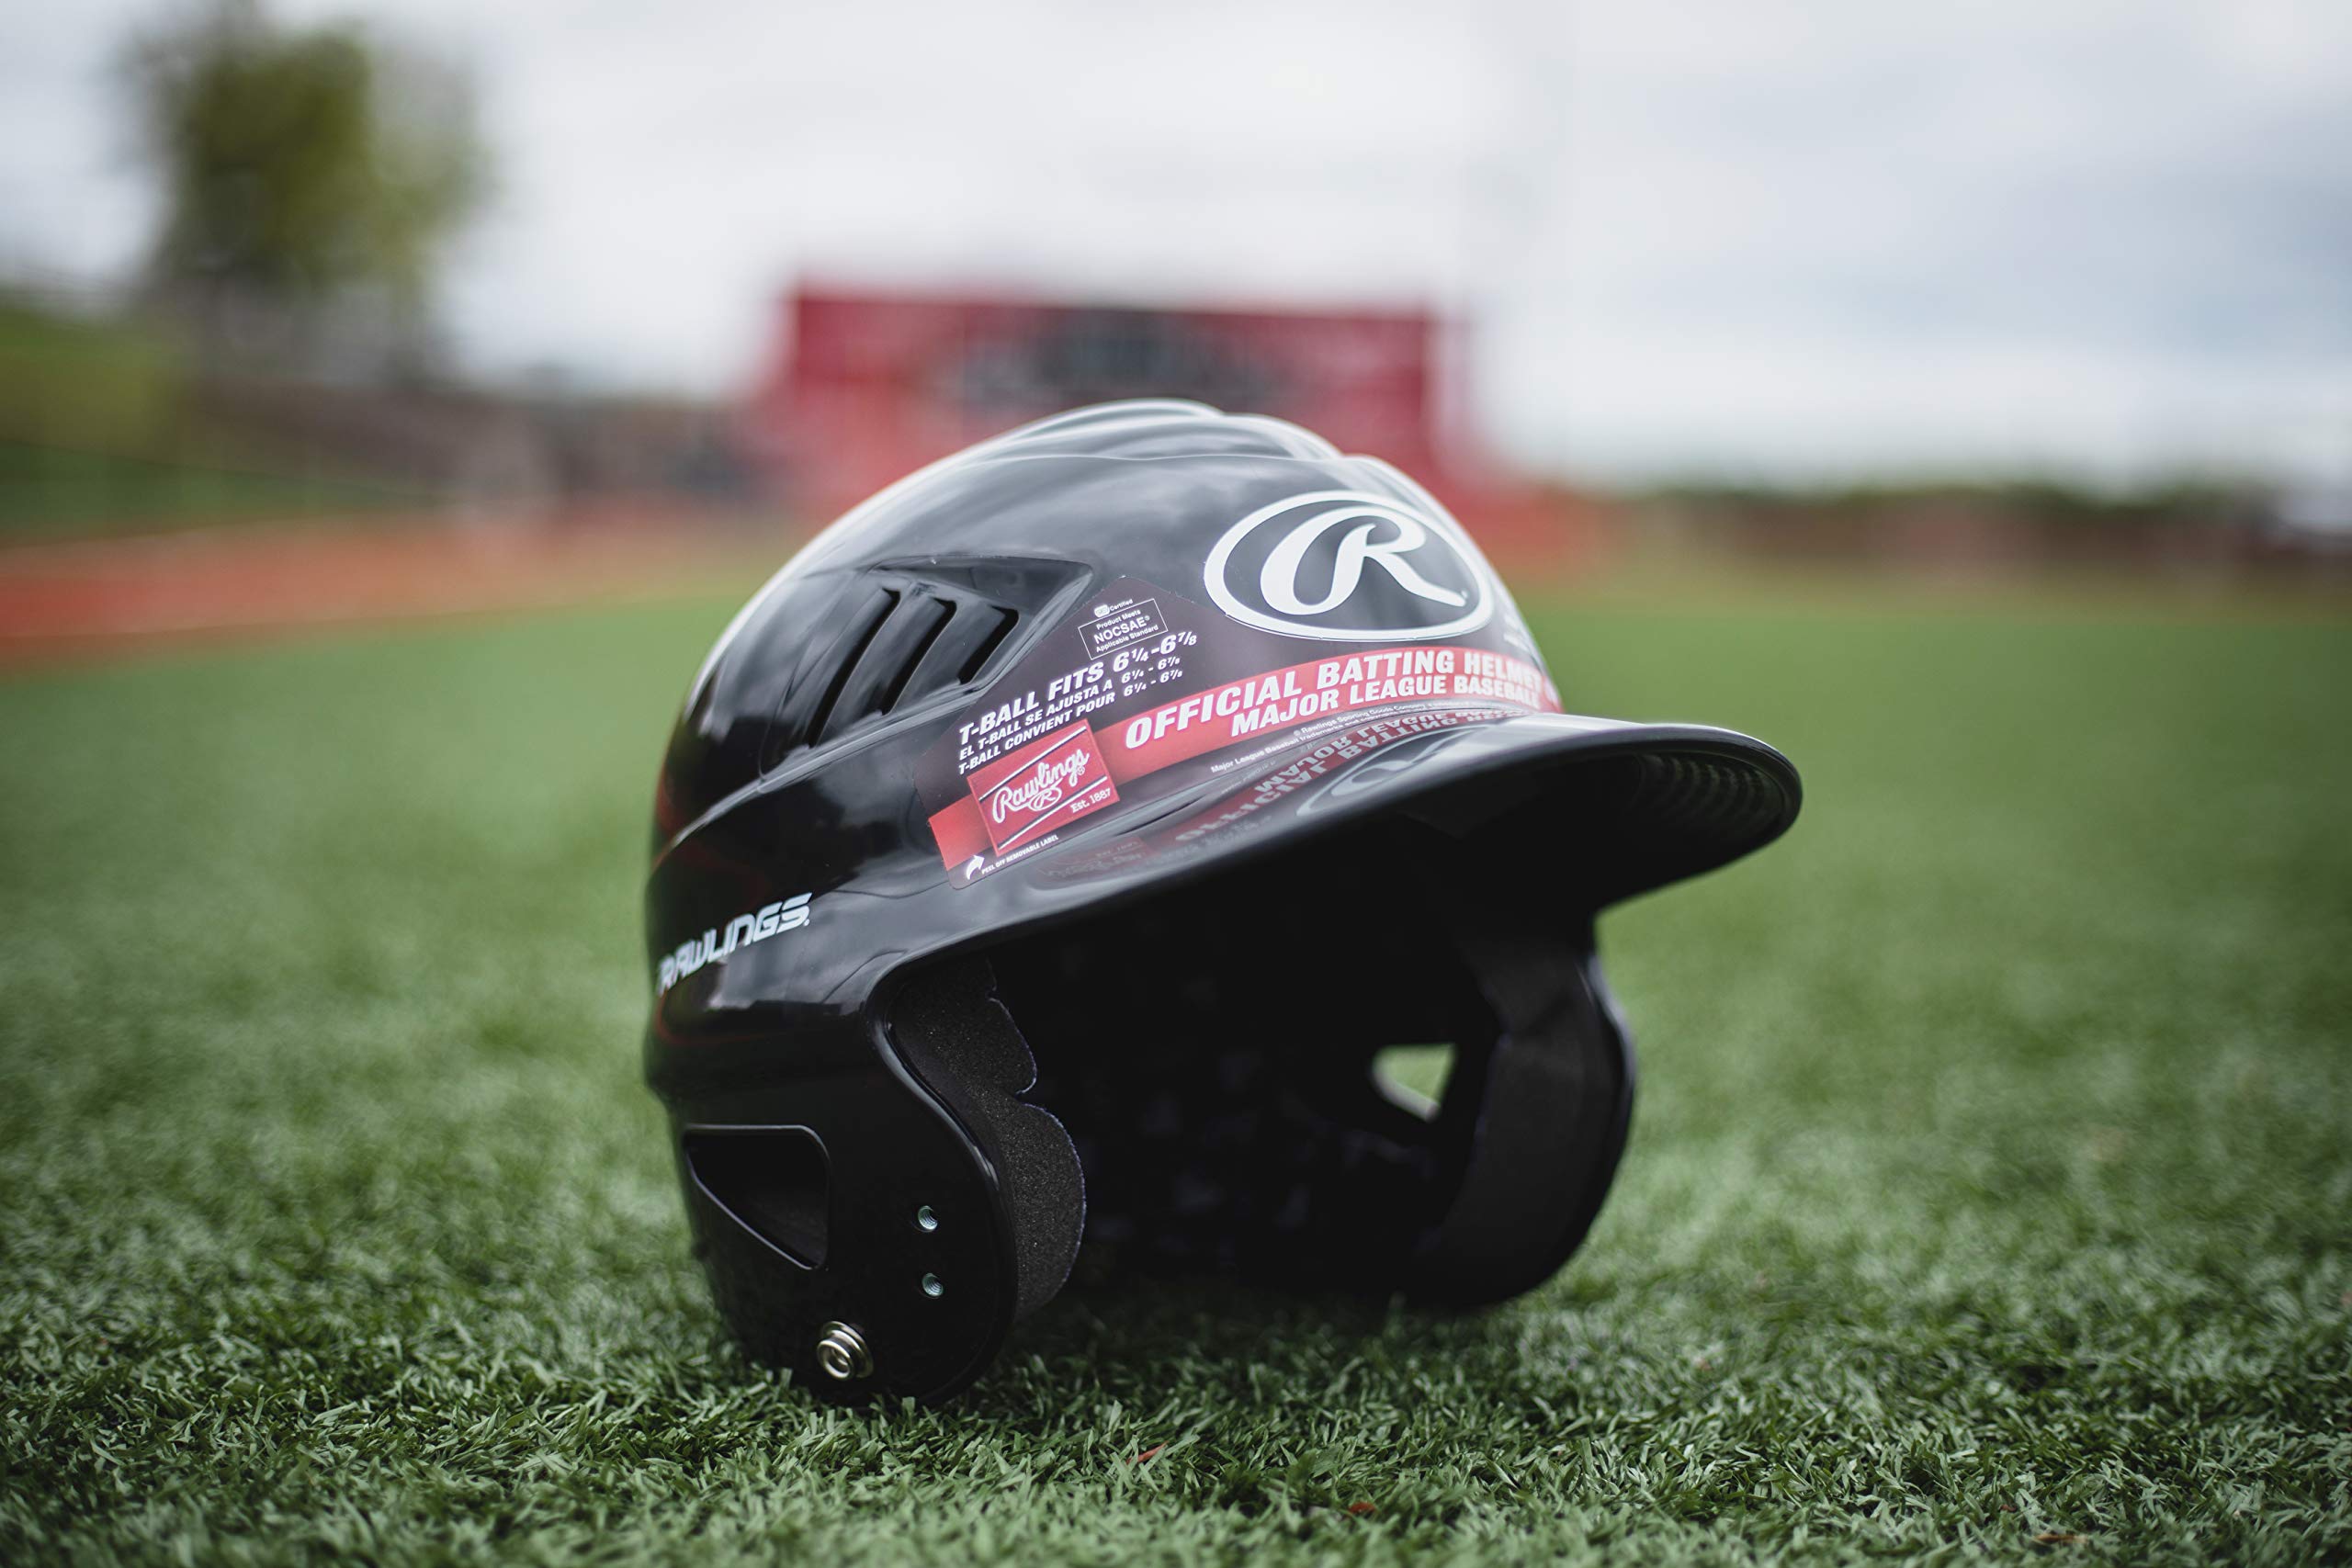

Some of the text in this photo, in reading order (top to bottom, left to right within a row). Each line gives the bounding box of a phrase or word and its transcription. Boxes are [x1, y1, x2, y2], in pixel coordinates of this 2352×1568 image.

[1096, 615, 1122, 630] Product
[1122, 609, 1141, 620] Meets
[1110, 599, 1133, 612] Certified
[1096, 625, 1159, 653] Applicable Standard
[959, 691, 1039, 745] T-BALL
[1047, 661, 1103, 701] FITS
[959, 746, 974, 761] EL
[978, 721, 1021, 750] T-BALL
[1024, 709, 1043, 726] SE
[1046, 685, 1099, 716] AJUSTA
[1102, 679, 1113, 692] A
[1125, 671, 1302, 750] OFFICIAL
[1317, 649, 1454, 690] BATTING
[1231, 690, 1339, 737] MAJOR
[1350, 675, 1447, 705] LEAGUE
[1301, 718, 1337, 735] Rawlings
[1337, 710, 1369, 726] Sporting
[1370, 705, 1393, 716] Goods
[958, 745, 1001, 774] T-BALL
[1004, 710, 1073, 750] CONVIENT
[1076, 692, 1115, 717] POUR
[1210, 761, 1234, 773] Major
[1235, 749, 1264, 764] League
[1264, 737, 1299, 754] Baseball
[1299, 724, 1344, 741] trademarks
[1069, 788, 1111, 814] Est. 1887
[981, 864, 995, 874] PEEL
[1006, 841, 1040, 863] REMOVABLE
[1041, 834, 1058, 847] LABEL
[658, 892, 813, 998] RAWLINGS
